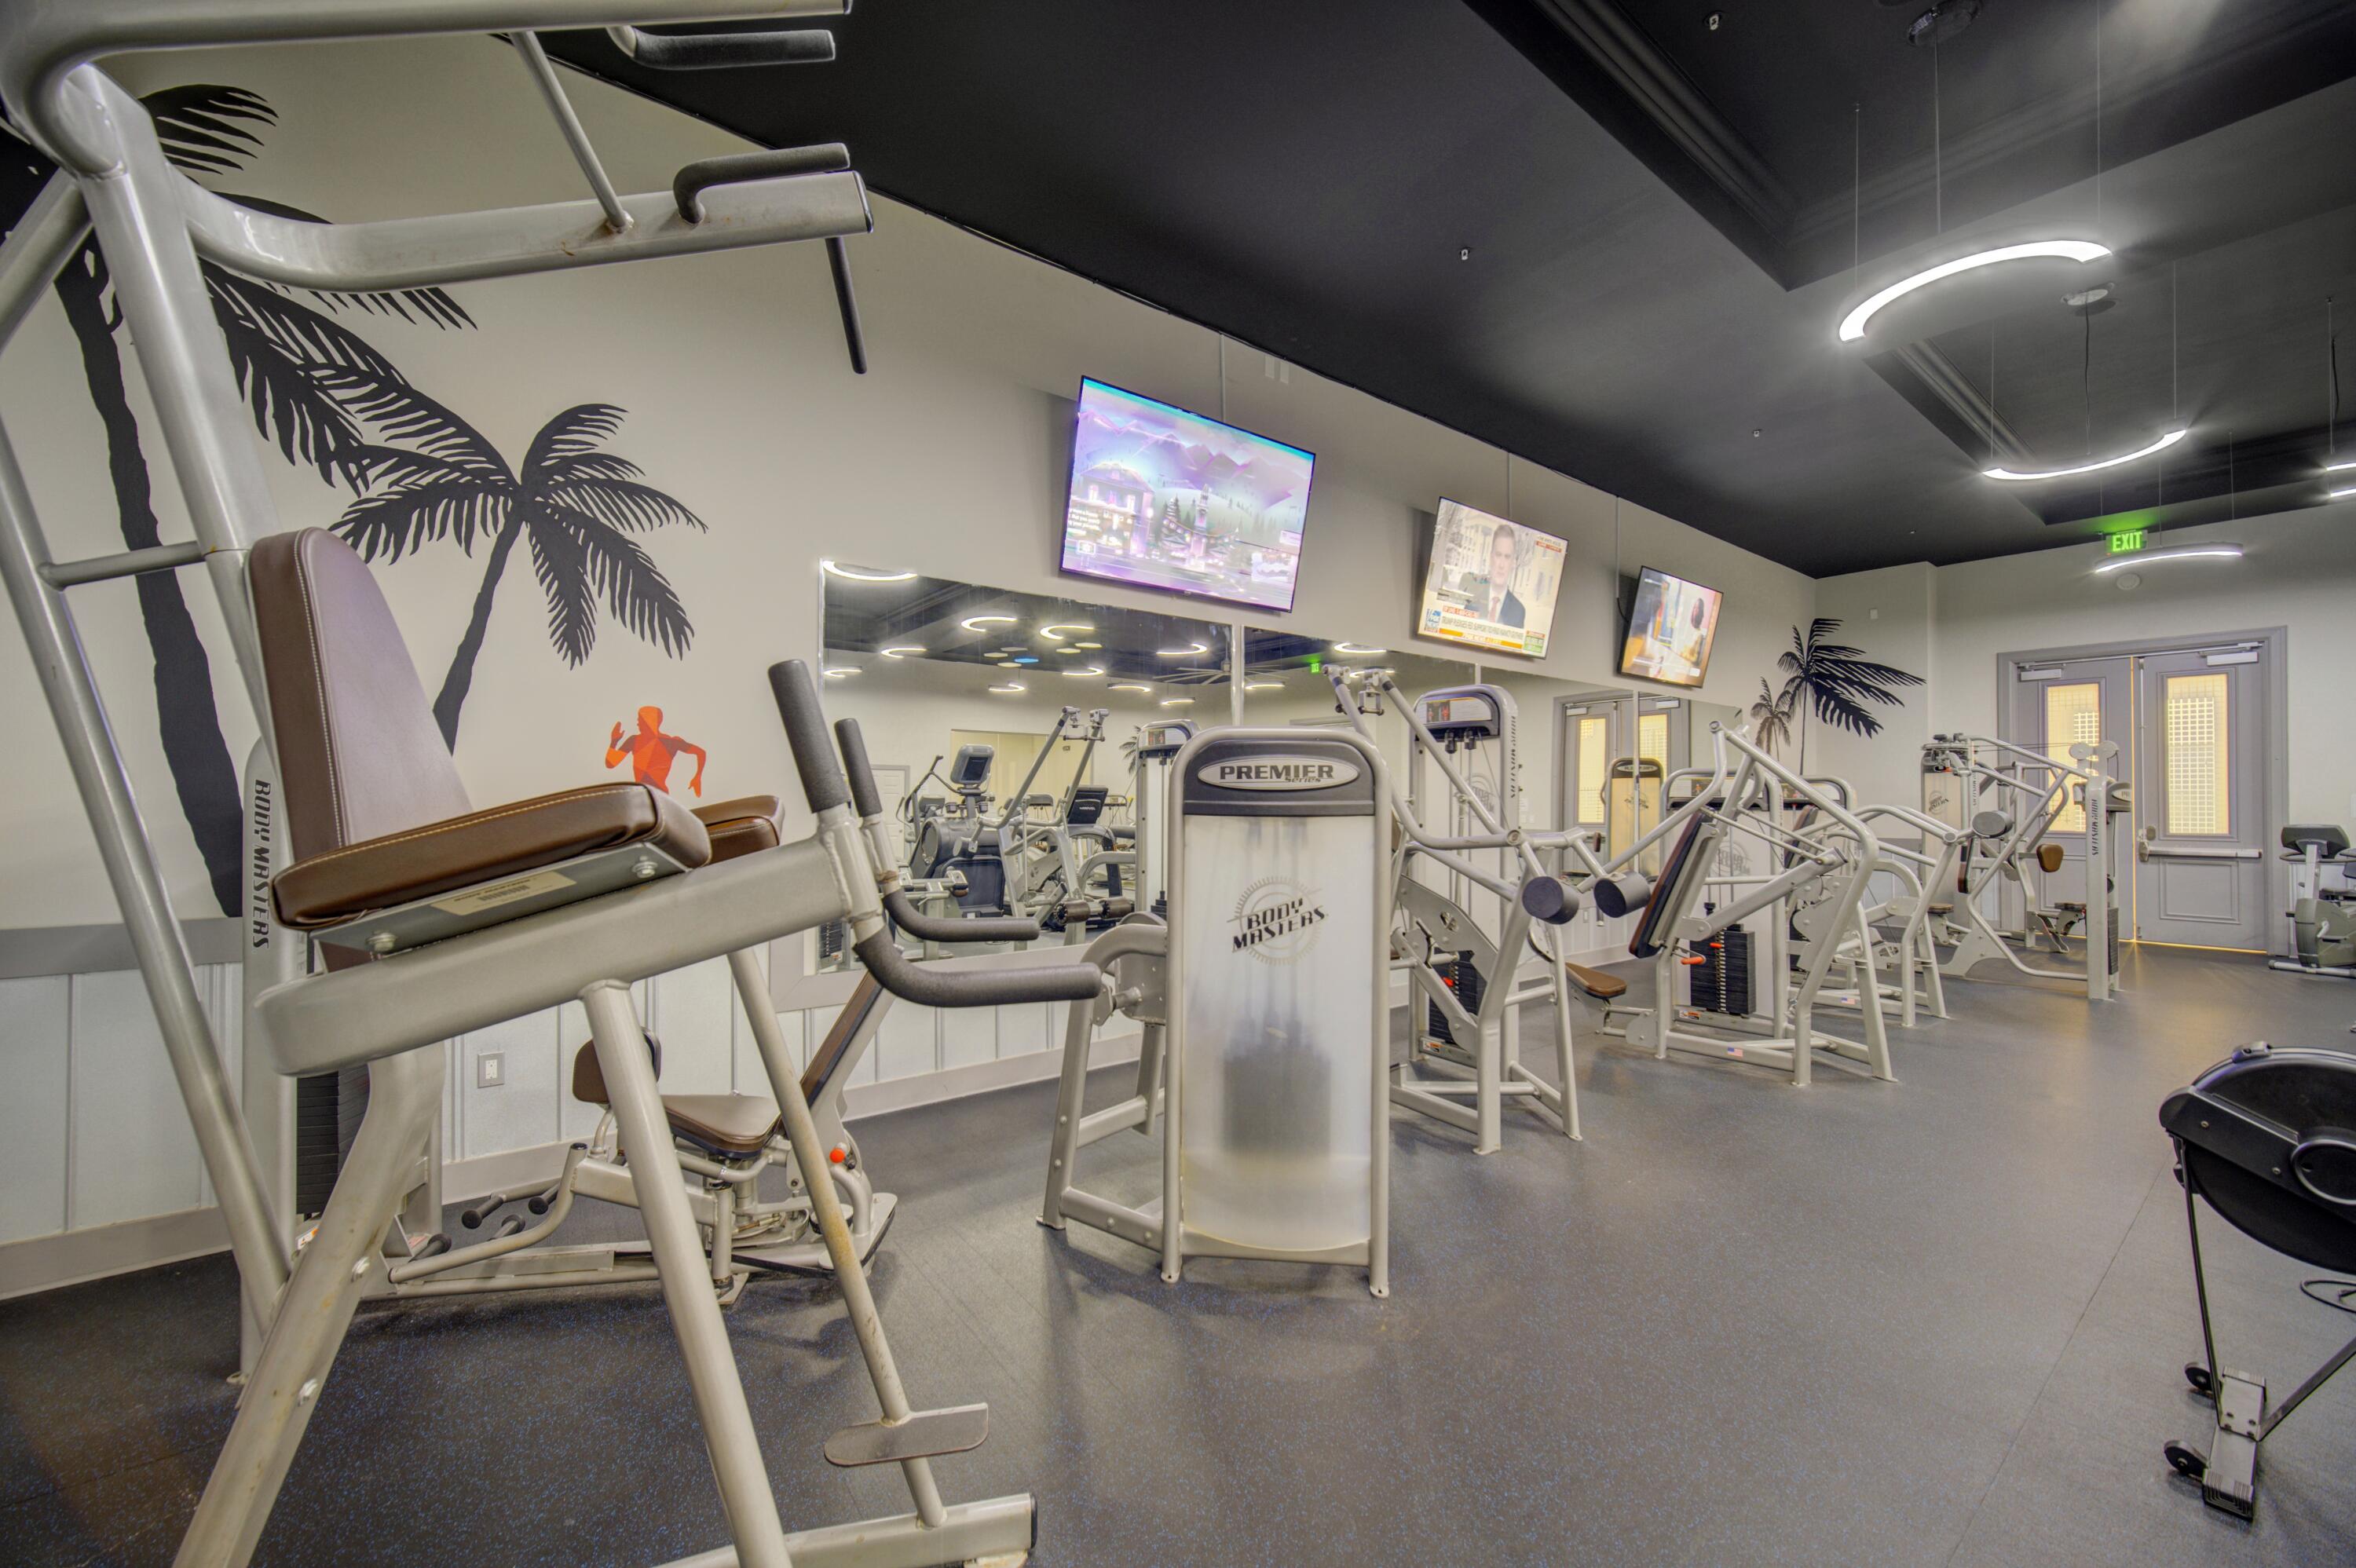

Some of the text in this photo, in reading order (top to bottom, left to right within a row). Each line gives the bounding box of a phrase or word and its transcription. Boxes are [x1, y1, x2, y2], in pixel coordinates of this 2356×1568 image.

[2112, 531, 2142, 551] EXIT
[1219, 765, 1334, 780] PREMIER
[252, 779, 271, 949] BODY MASTERS
[1231, 905, 1326, 953] MASTERS
[1247, 897, 1304, 930] BODY
